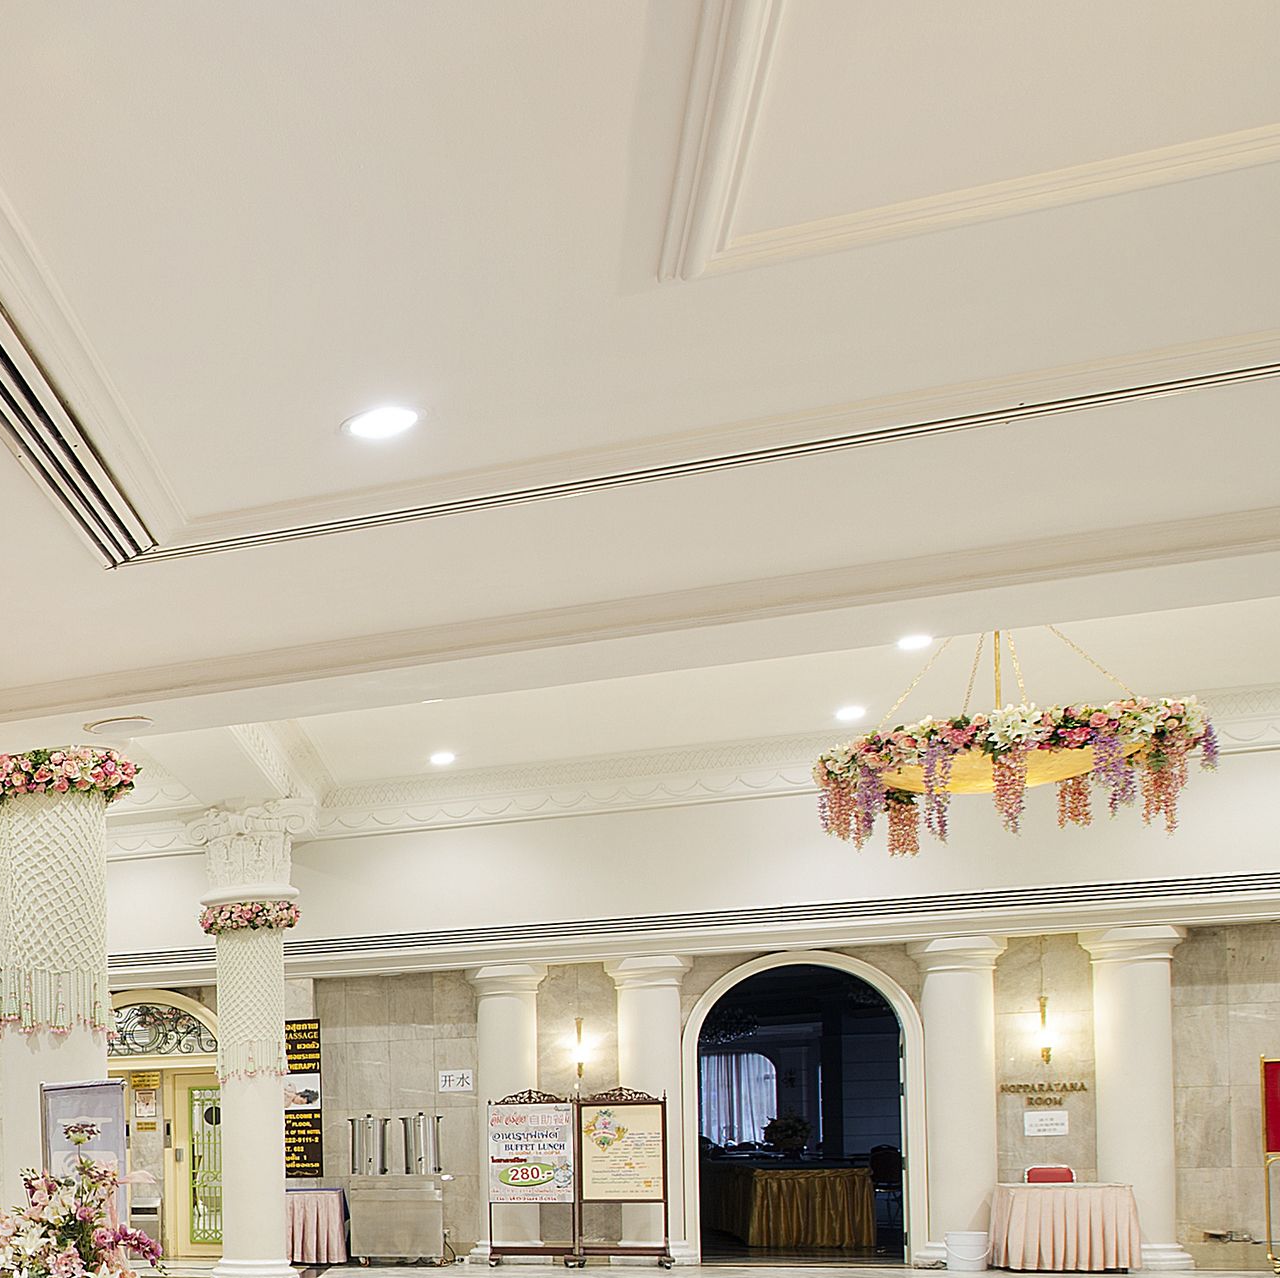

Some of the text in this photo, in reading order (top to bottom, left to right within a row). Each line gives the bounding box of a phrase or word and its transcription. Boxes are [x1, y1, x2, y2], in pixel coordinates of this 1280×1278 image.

[441, 1073, 471, 1088] 开水
[1026, 1097, 1064, 1106] ROOM
[504, 1143, 565, 1151] BUFFET LUNCH
